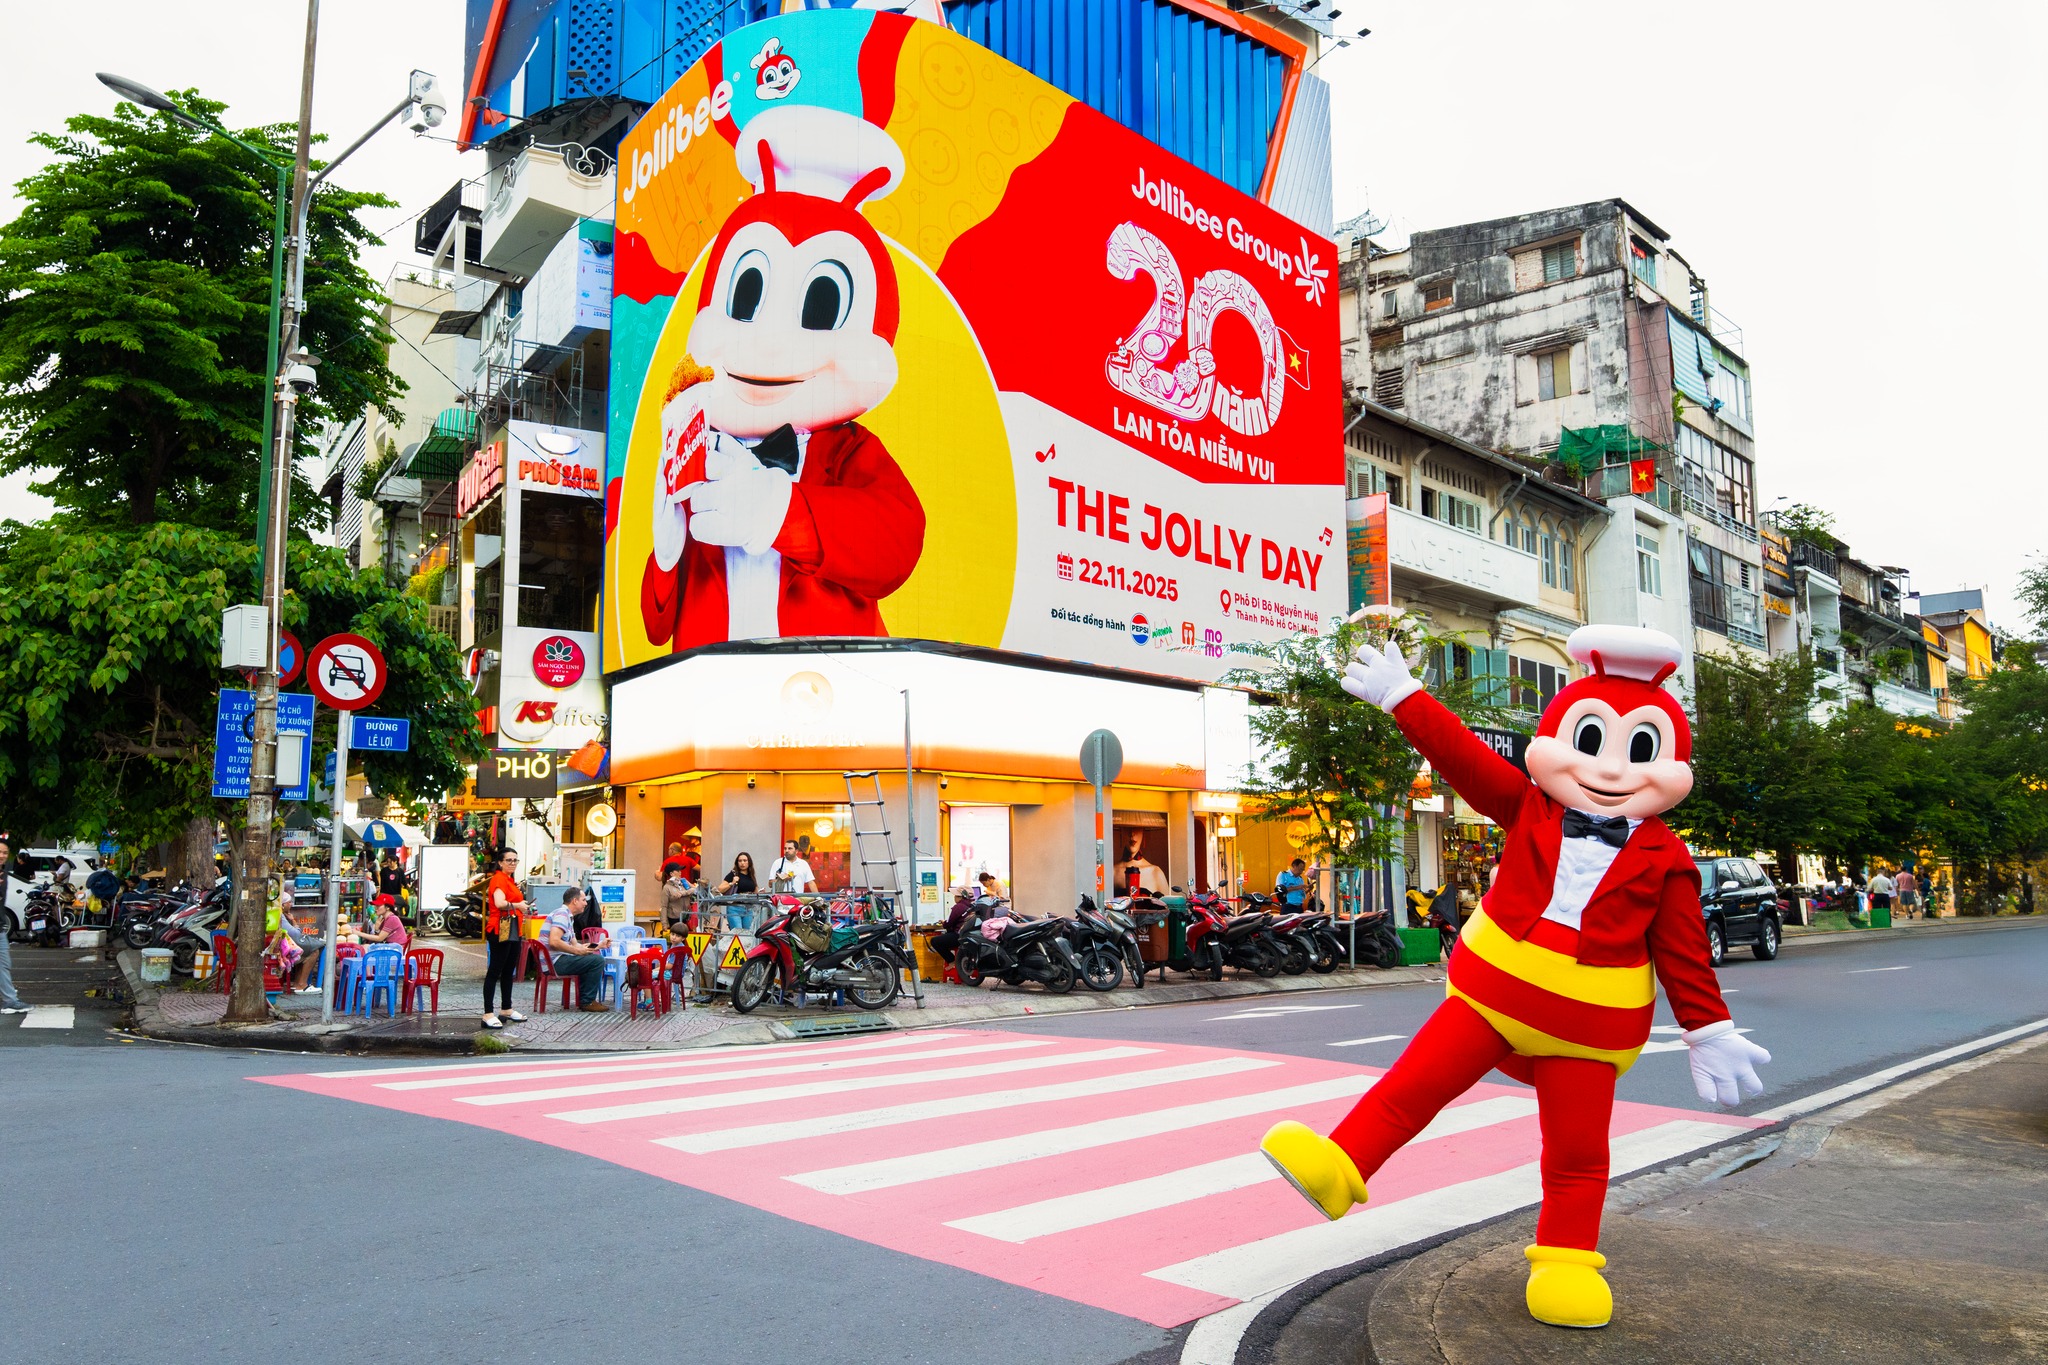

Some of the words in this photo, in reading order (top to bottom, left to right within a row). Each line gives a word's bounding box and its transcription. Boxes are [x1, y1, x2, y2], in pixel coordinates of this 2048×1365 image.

[623, 80, 733, 204] Jollibee
[1132, 167, 1223, 240] Jollibee
[1227, 217, 1292, 280] Group
[1105, 220, 1285, 427] 20
[1212, 381, 1269, 436] năm
[1113, 406, 1152, 441] LAN
[1157, 420, 1196, 456] TỎA
[1200, 434, 1243, 472] NIỀM
[1247, 454, 1275, 483] VUI
[562, 464, 597, 482] SÂM
[1048, 476, 1130, 544] THE
[1140, 503, 1252, 573] JOLLY
[1261, 538, 1323, 592] DAY
[1078, 558, 1179, 602] 22.11.2025
[1051, 607, 1067, 621] Đối
[1067, 611, 1081, 623] tác
[1082, 613, 1104, 629] đồng
[1105, 619, 1126, 632] hành
[1234, 593, 1250, 606] Phố
[1251, 597, 1260, 609] Đi
[1262, 600, 1273, 614] Bộ
[1274, 603, 1302, 618] Nguyễn
[1304, 609, 1319, 624] Huệ
[1131, 624, 1149, 634] PEPSI
[1236, 609, 1258, 622] Thành
[1260, 615, 1274, 626] Phố
[1301, 624, 1319, 636] Minh
[244, 702, 249, 711] Ô
[278, 695, 288, 703] RỪ
[232, 712, 243, 721] TẢI
[277, 716, 287, 724] RỞ
[287, 716, 311, 726] XUỐNG
[515, 700, 558, 723] K5
[365, 720, 398, 731] ĐƯỜNG
[368, 734, 378, 747] LÊ
[380, 736, 393, 748] LỢI
[226, 766, 246, 774] NGÀY
[496, 752, 551, 779] PHỞ
[219, 787, 242, 796] THÀNH
[285, 790, 303, 798] MINH
[226, 777, 239, 785] HỘI
